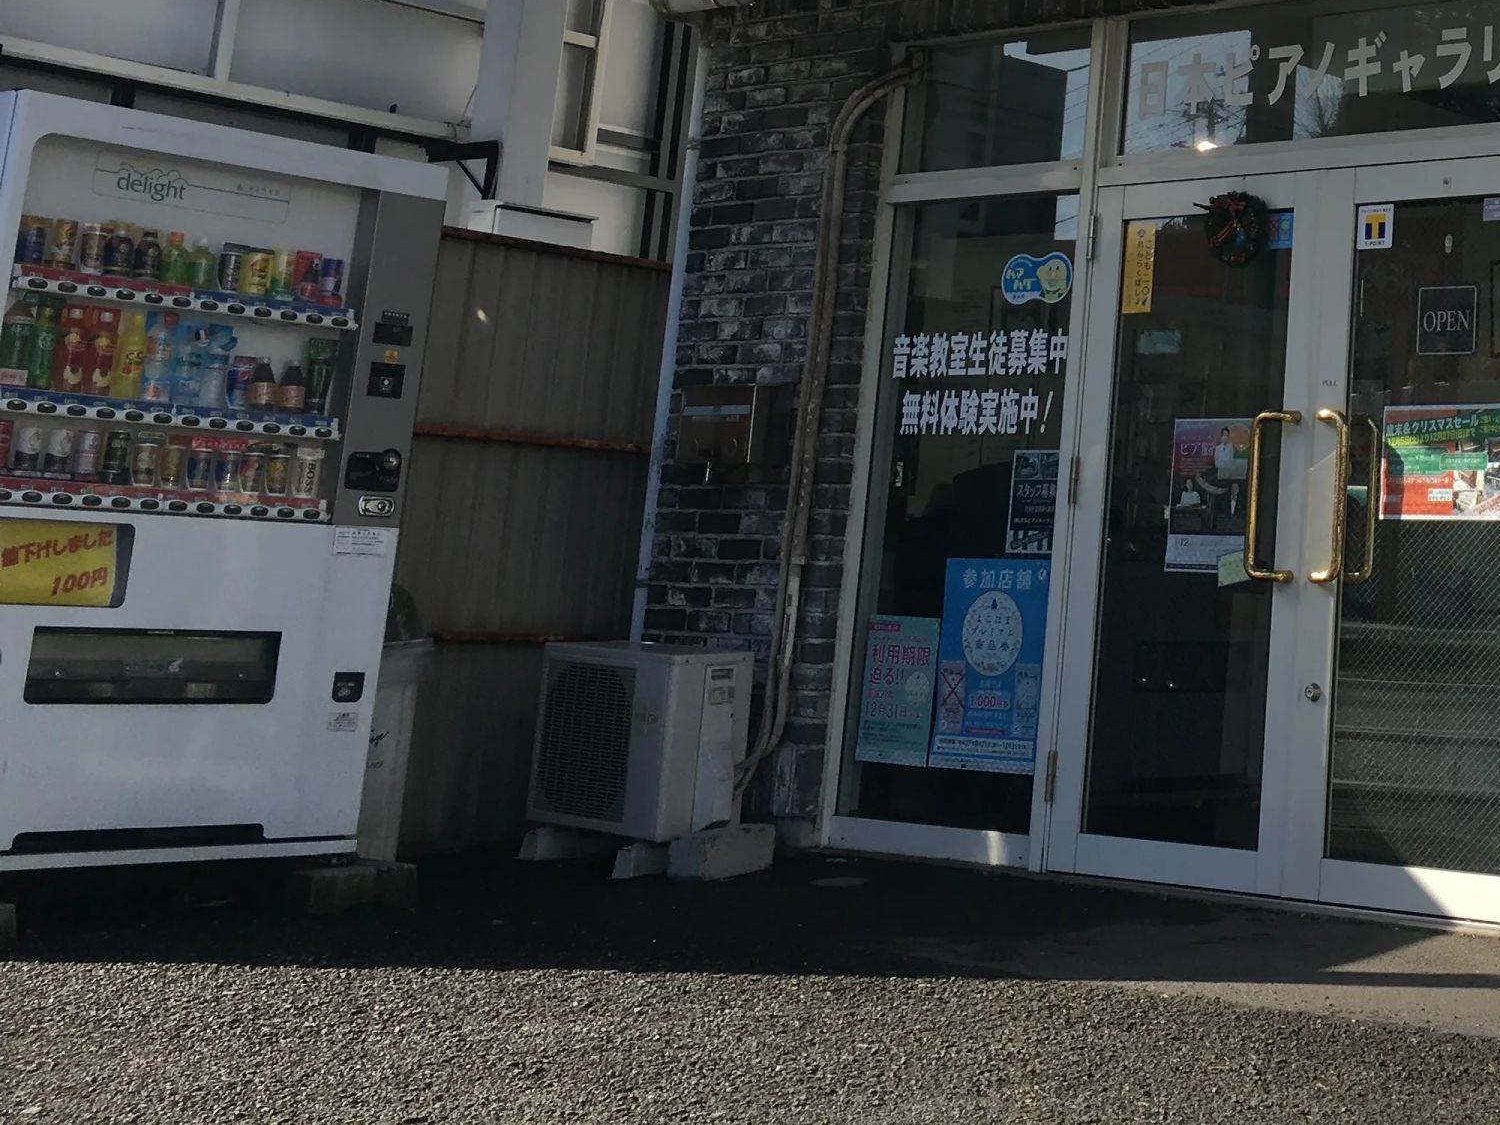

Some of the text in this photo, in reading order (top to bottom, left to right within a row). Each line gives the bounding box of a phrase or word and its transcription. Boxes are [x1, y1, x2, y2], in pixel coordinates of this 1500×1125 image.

[116, 173, 186, 202] delight
[1423, 309, 1471, 332] OPEN
[892, 327, 1069, 379] 音楽教室生徒募集中
[899, 387, 1054, 436] 無料体験実施中!
[51, 566, 109, 596] 100円
[963, 568, 1033, 590] 参加店舗
[871, 643, 931, 668] 利用期限
